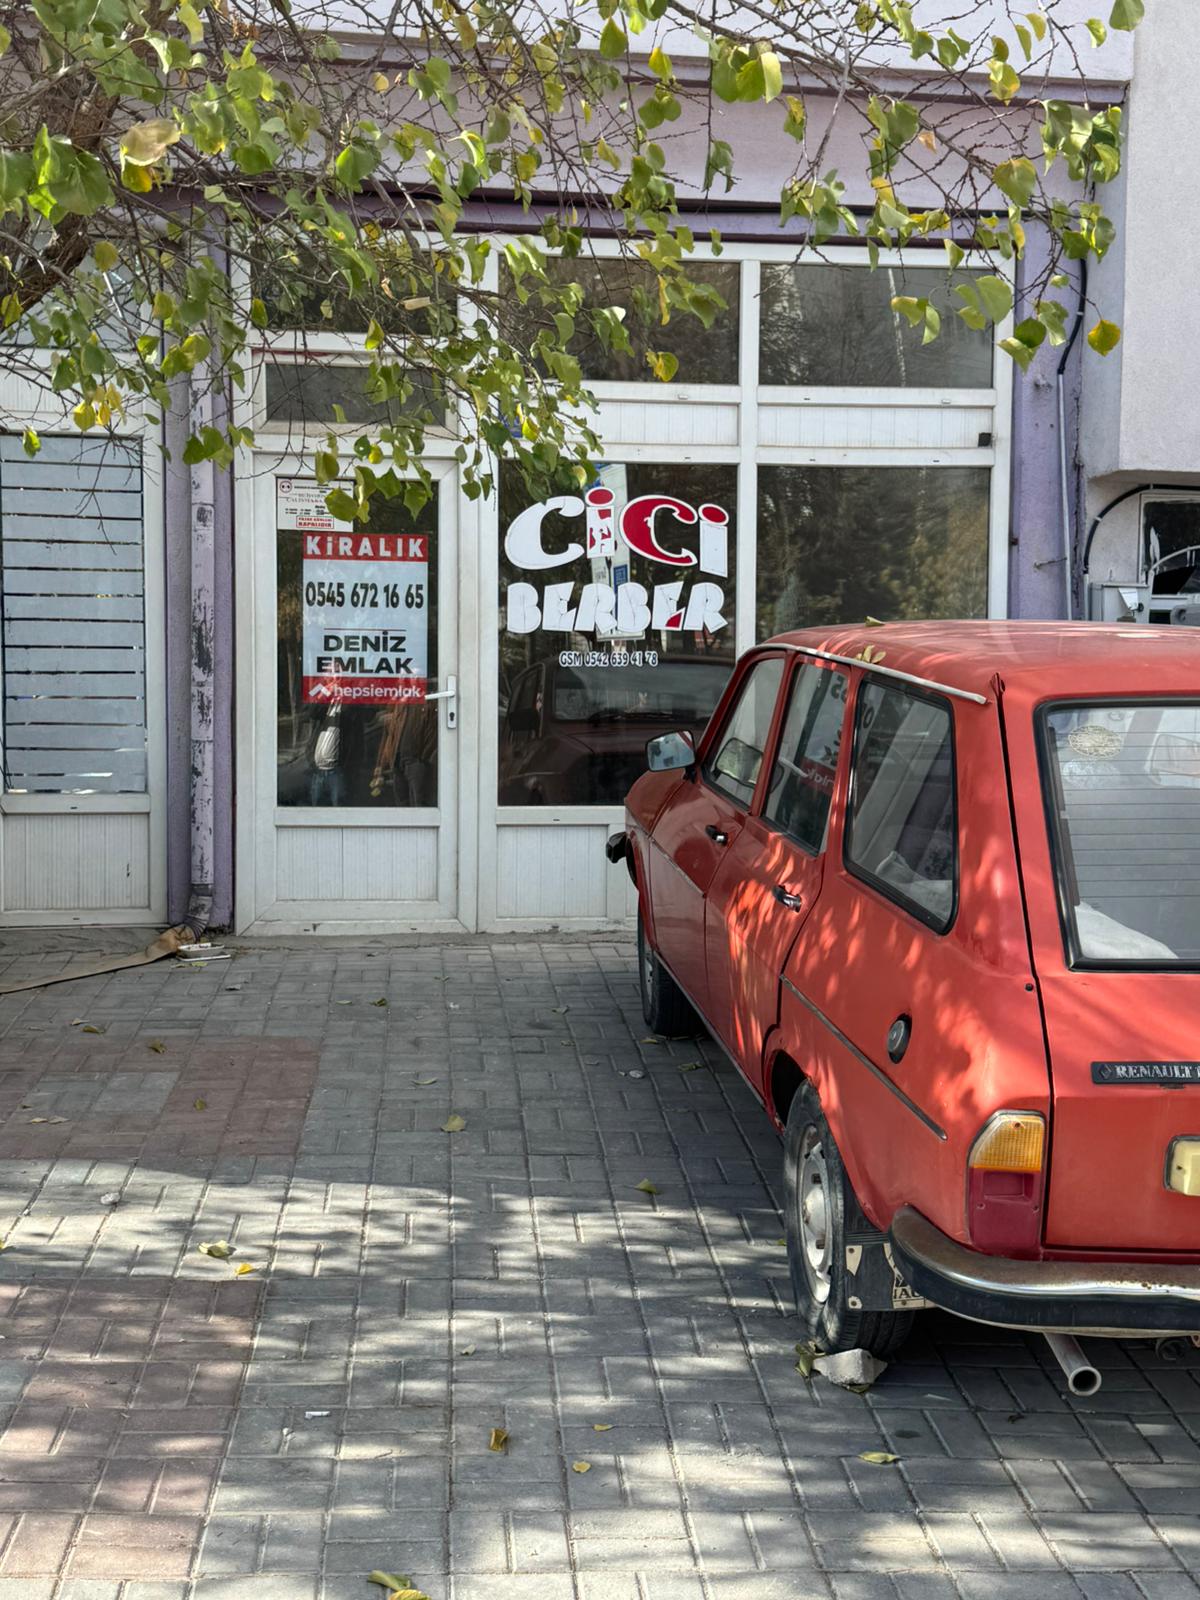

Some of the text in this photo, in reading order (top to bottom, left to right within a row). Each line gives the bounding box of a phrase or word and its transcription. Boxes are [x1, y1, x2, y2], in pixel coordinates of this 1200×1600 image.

[305, 581, 424, 609] 0545 672 16 65
[507, 581, 729, 634] BERBER
[324, 630, 406, 652] DENİZ
[316, 656, 414, 674] EMLAK
[559, 651, 582, 667] GSM
[584, 651, 609, 667] 0542
[610, 651, 629, 667] 639
[631, 651, 643, 667] 41
[334, 684, 421, 699] hepsiemlak
[1115, 1065, 1193, 1078] RENAULT
